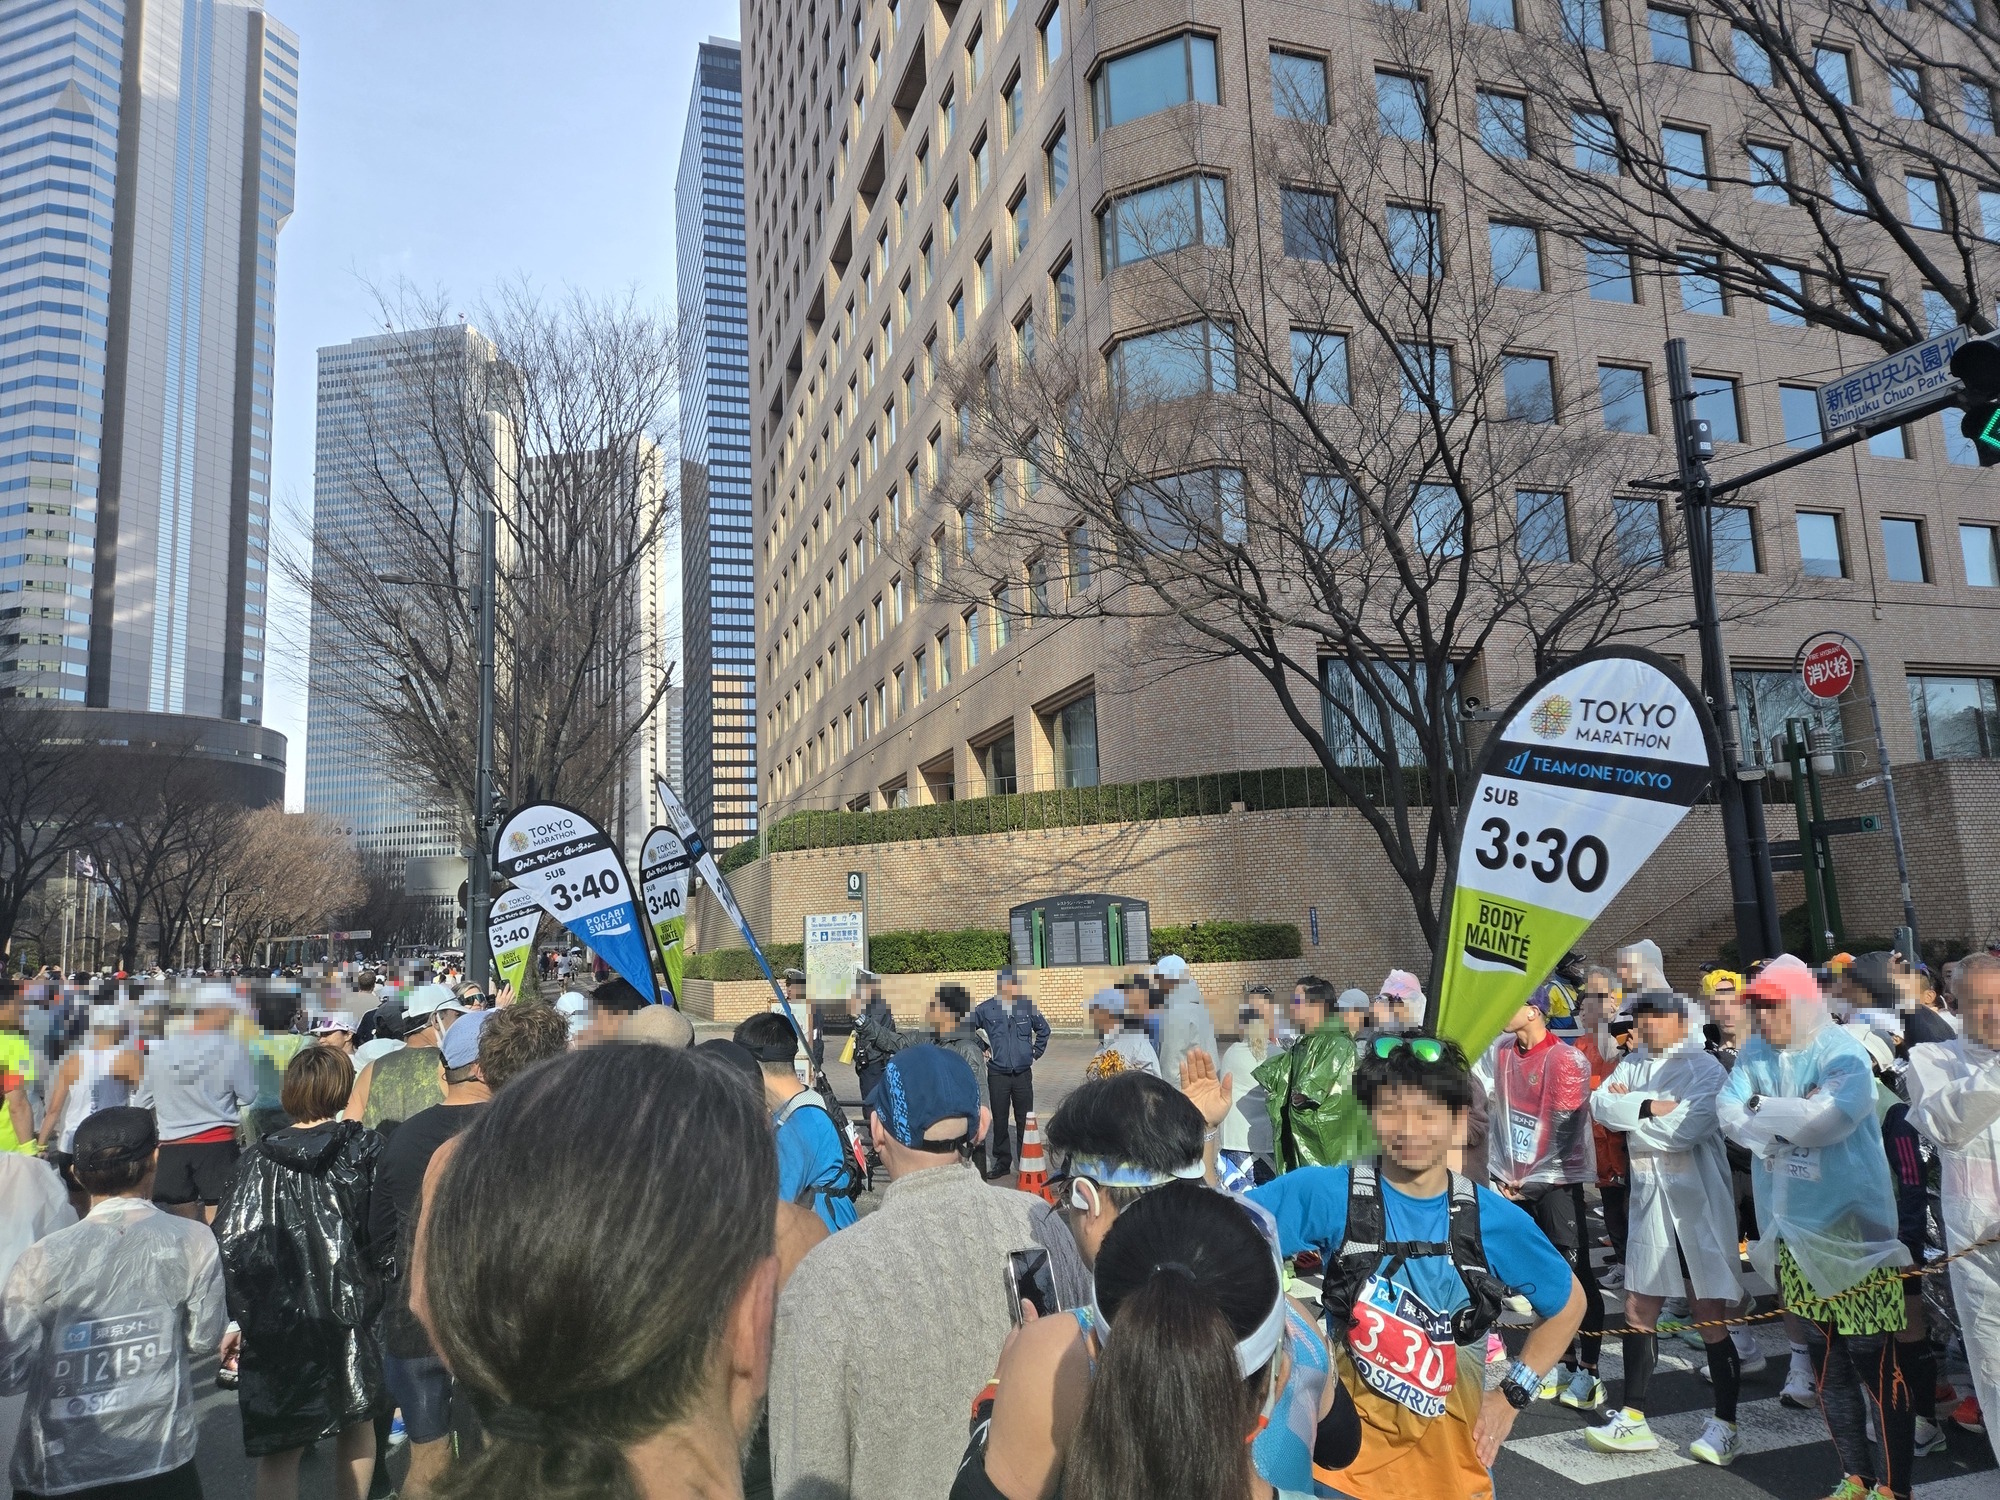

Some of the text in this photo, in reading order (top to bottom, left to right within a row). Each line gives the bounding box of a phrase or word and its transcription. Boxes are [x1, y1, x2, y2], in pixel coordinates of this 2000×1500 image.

[1825, 337, 1960, 412] 新宿中央公園北
[1829, 371, 1948, 427] Shinjuku Chuo Park
[1808, 645, 1841, 662] FIRE HYDRANT
[1807, 655, 1850, 686] 消火栓
[1579, 698, 1677, 729] TOKYO
[1576, 727, 1671, 750] MARATHON
[1482, 785, 1519, 807] SUB
[528, 818, 574, 839] TOKYO
[532, 828, 577, 847] MARATHON
[656, 840, 677, 854] TOKYO
[658, 849, 679, 860] MARATHON
[1475, 816, 1609, 893] 3:30
[544, 867, 566, 881] SUB
[550, 868, 620, 911] 3:40
[645, 883, 656, 893] SUB
[508, 894, 531, 906] TOKYO
[509, 900, 532, 910] MARATHON
[648, 888, 681, 915] 3:40
[585, 907, 625, 927] POCARI
[588, 916, 623, 934] SWEAT
[1479, 903, 1525, 934] BODY
[491, 926, 503, 934] SUB
[493, 926, 529, 948] 3:40
[1466, 922, 1531, 961] MAINTÉ
[503, 951, 516, 960] BODY
[96, 1320, 160, 1339] 東京メトロ
[1354, 1310, 1452, 1393] 3 hr 30 min
[55, 1342, 157, 1385] D 12159
[56, 1385, 67, 1397] 2
